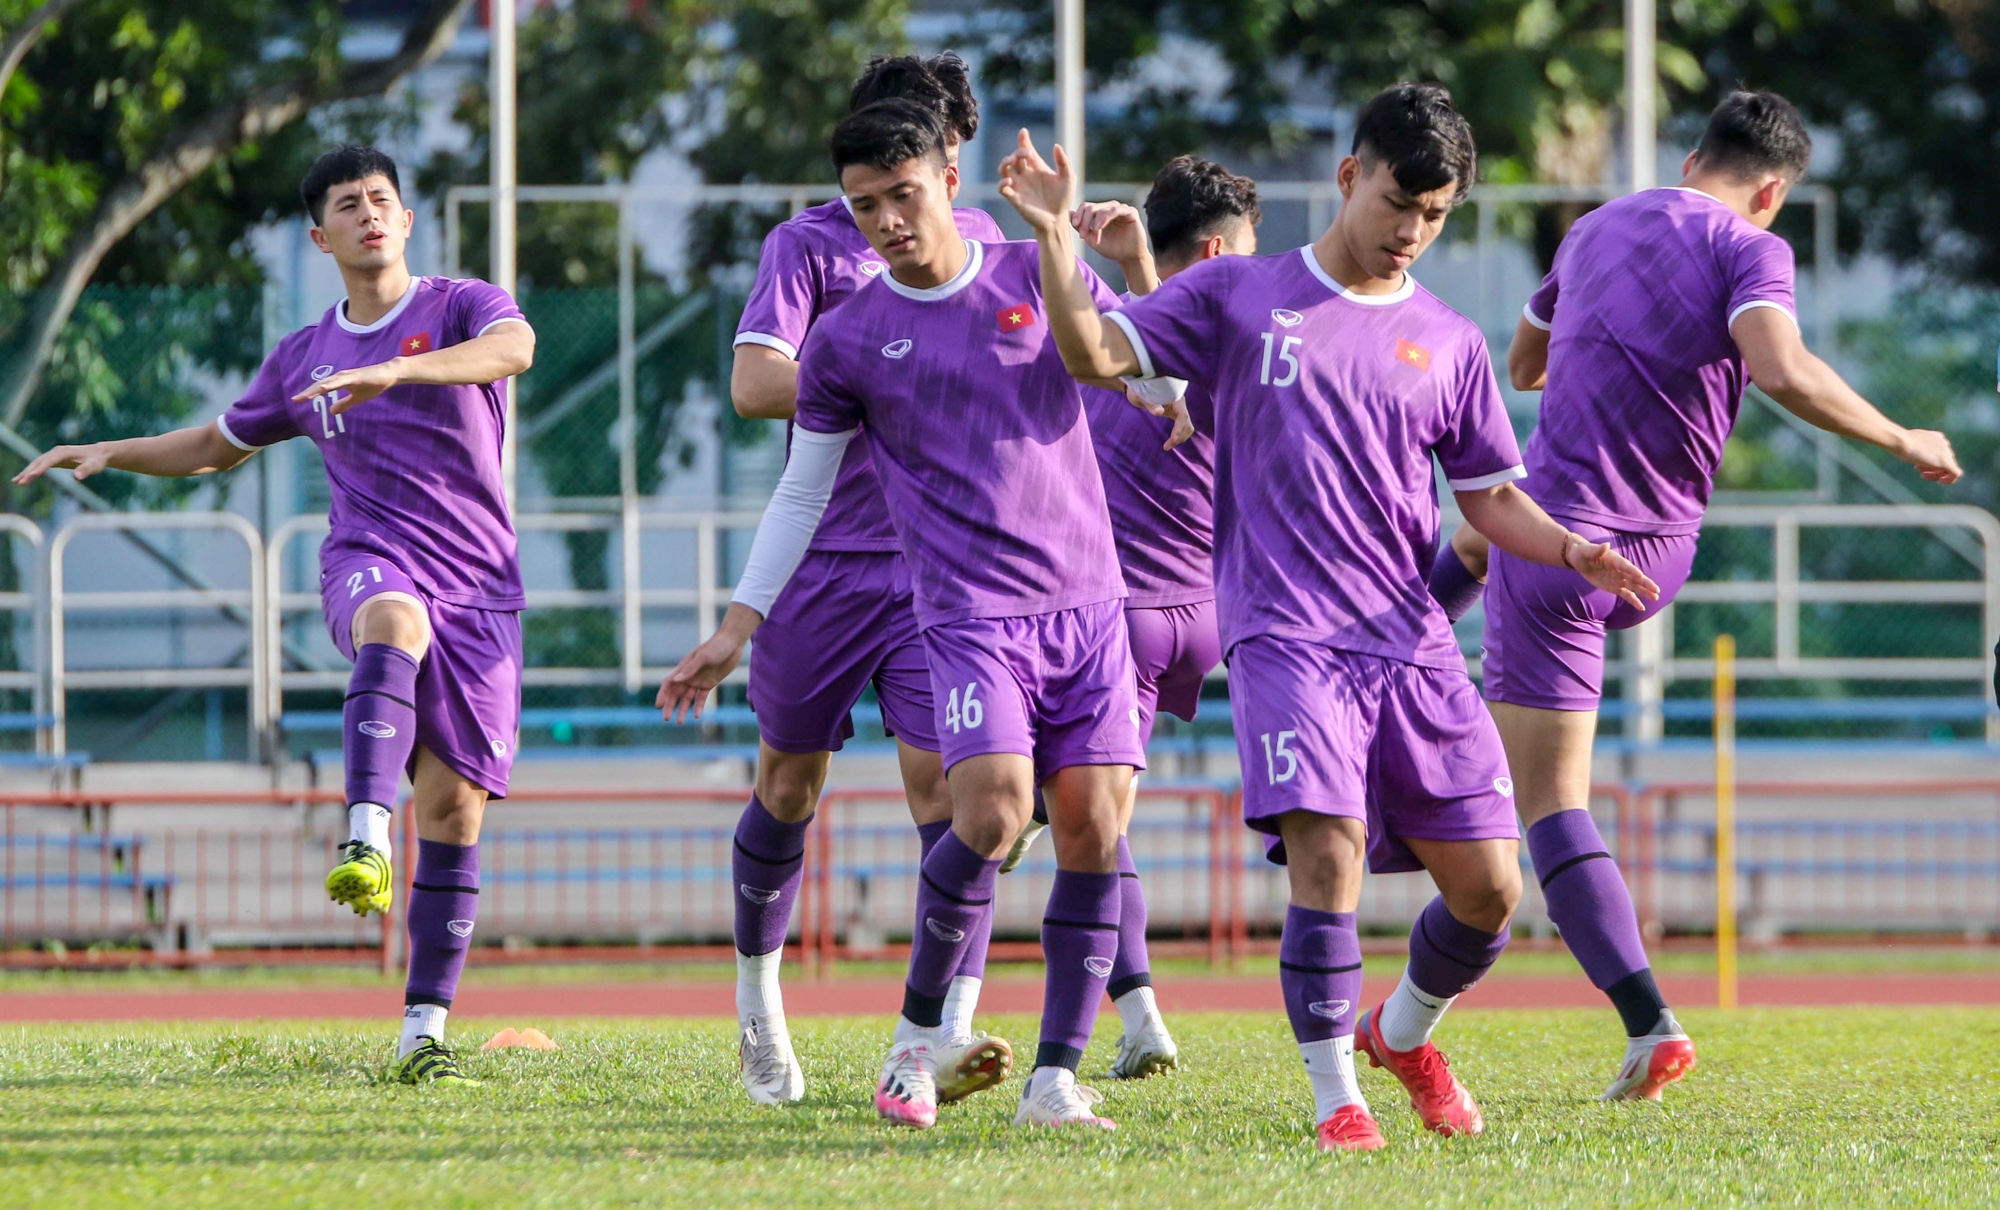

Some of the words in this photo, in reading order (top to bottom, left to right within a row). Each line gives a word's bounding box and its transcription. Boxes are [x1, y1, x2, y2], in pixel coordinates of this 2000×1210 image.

[1260, 332, 1302, 387] 15
[312, 390, 346, 439] 21
[346, 566, 383, 599] 21
[945, 681, 984, 735] 46
[1260, 730, 1297, 786] 15
